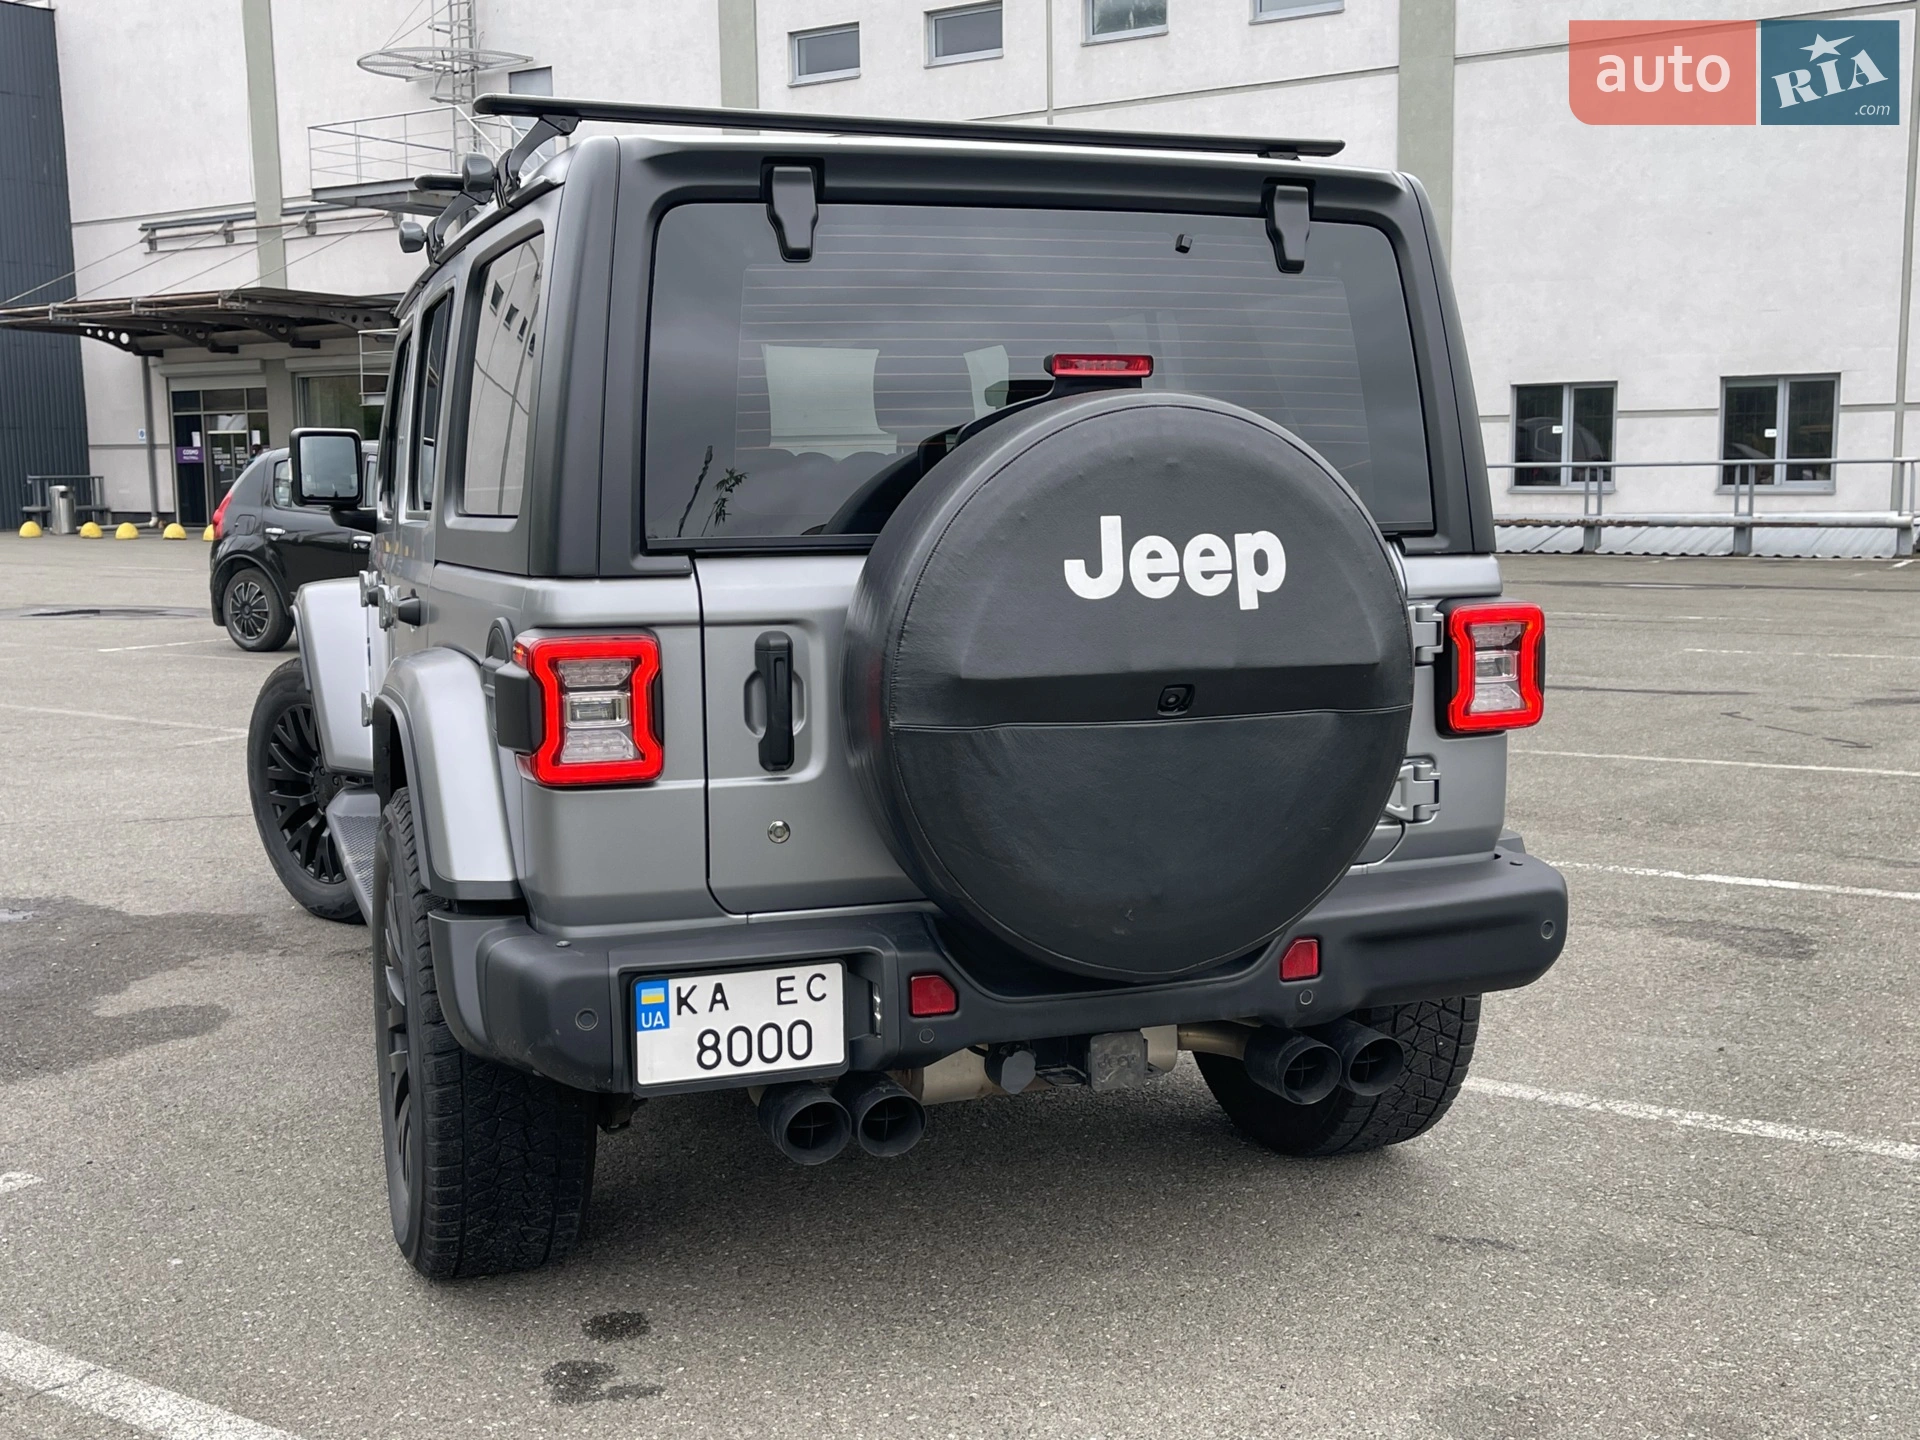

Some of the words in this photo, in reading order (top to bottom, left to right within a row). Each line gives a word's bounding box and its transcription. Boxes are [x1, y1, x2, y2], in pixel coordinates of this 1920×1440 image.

[1064, 515, 1287, 611] Jeep
[675, 981, 730, 1016] KA
[776, 973, 827, 1006] EC
[641, 1010, 665, 1028] UA
[696, 1019, 813, 1071] 8000
